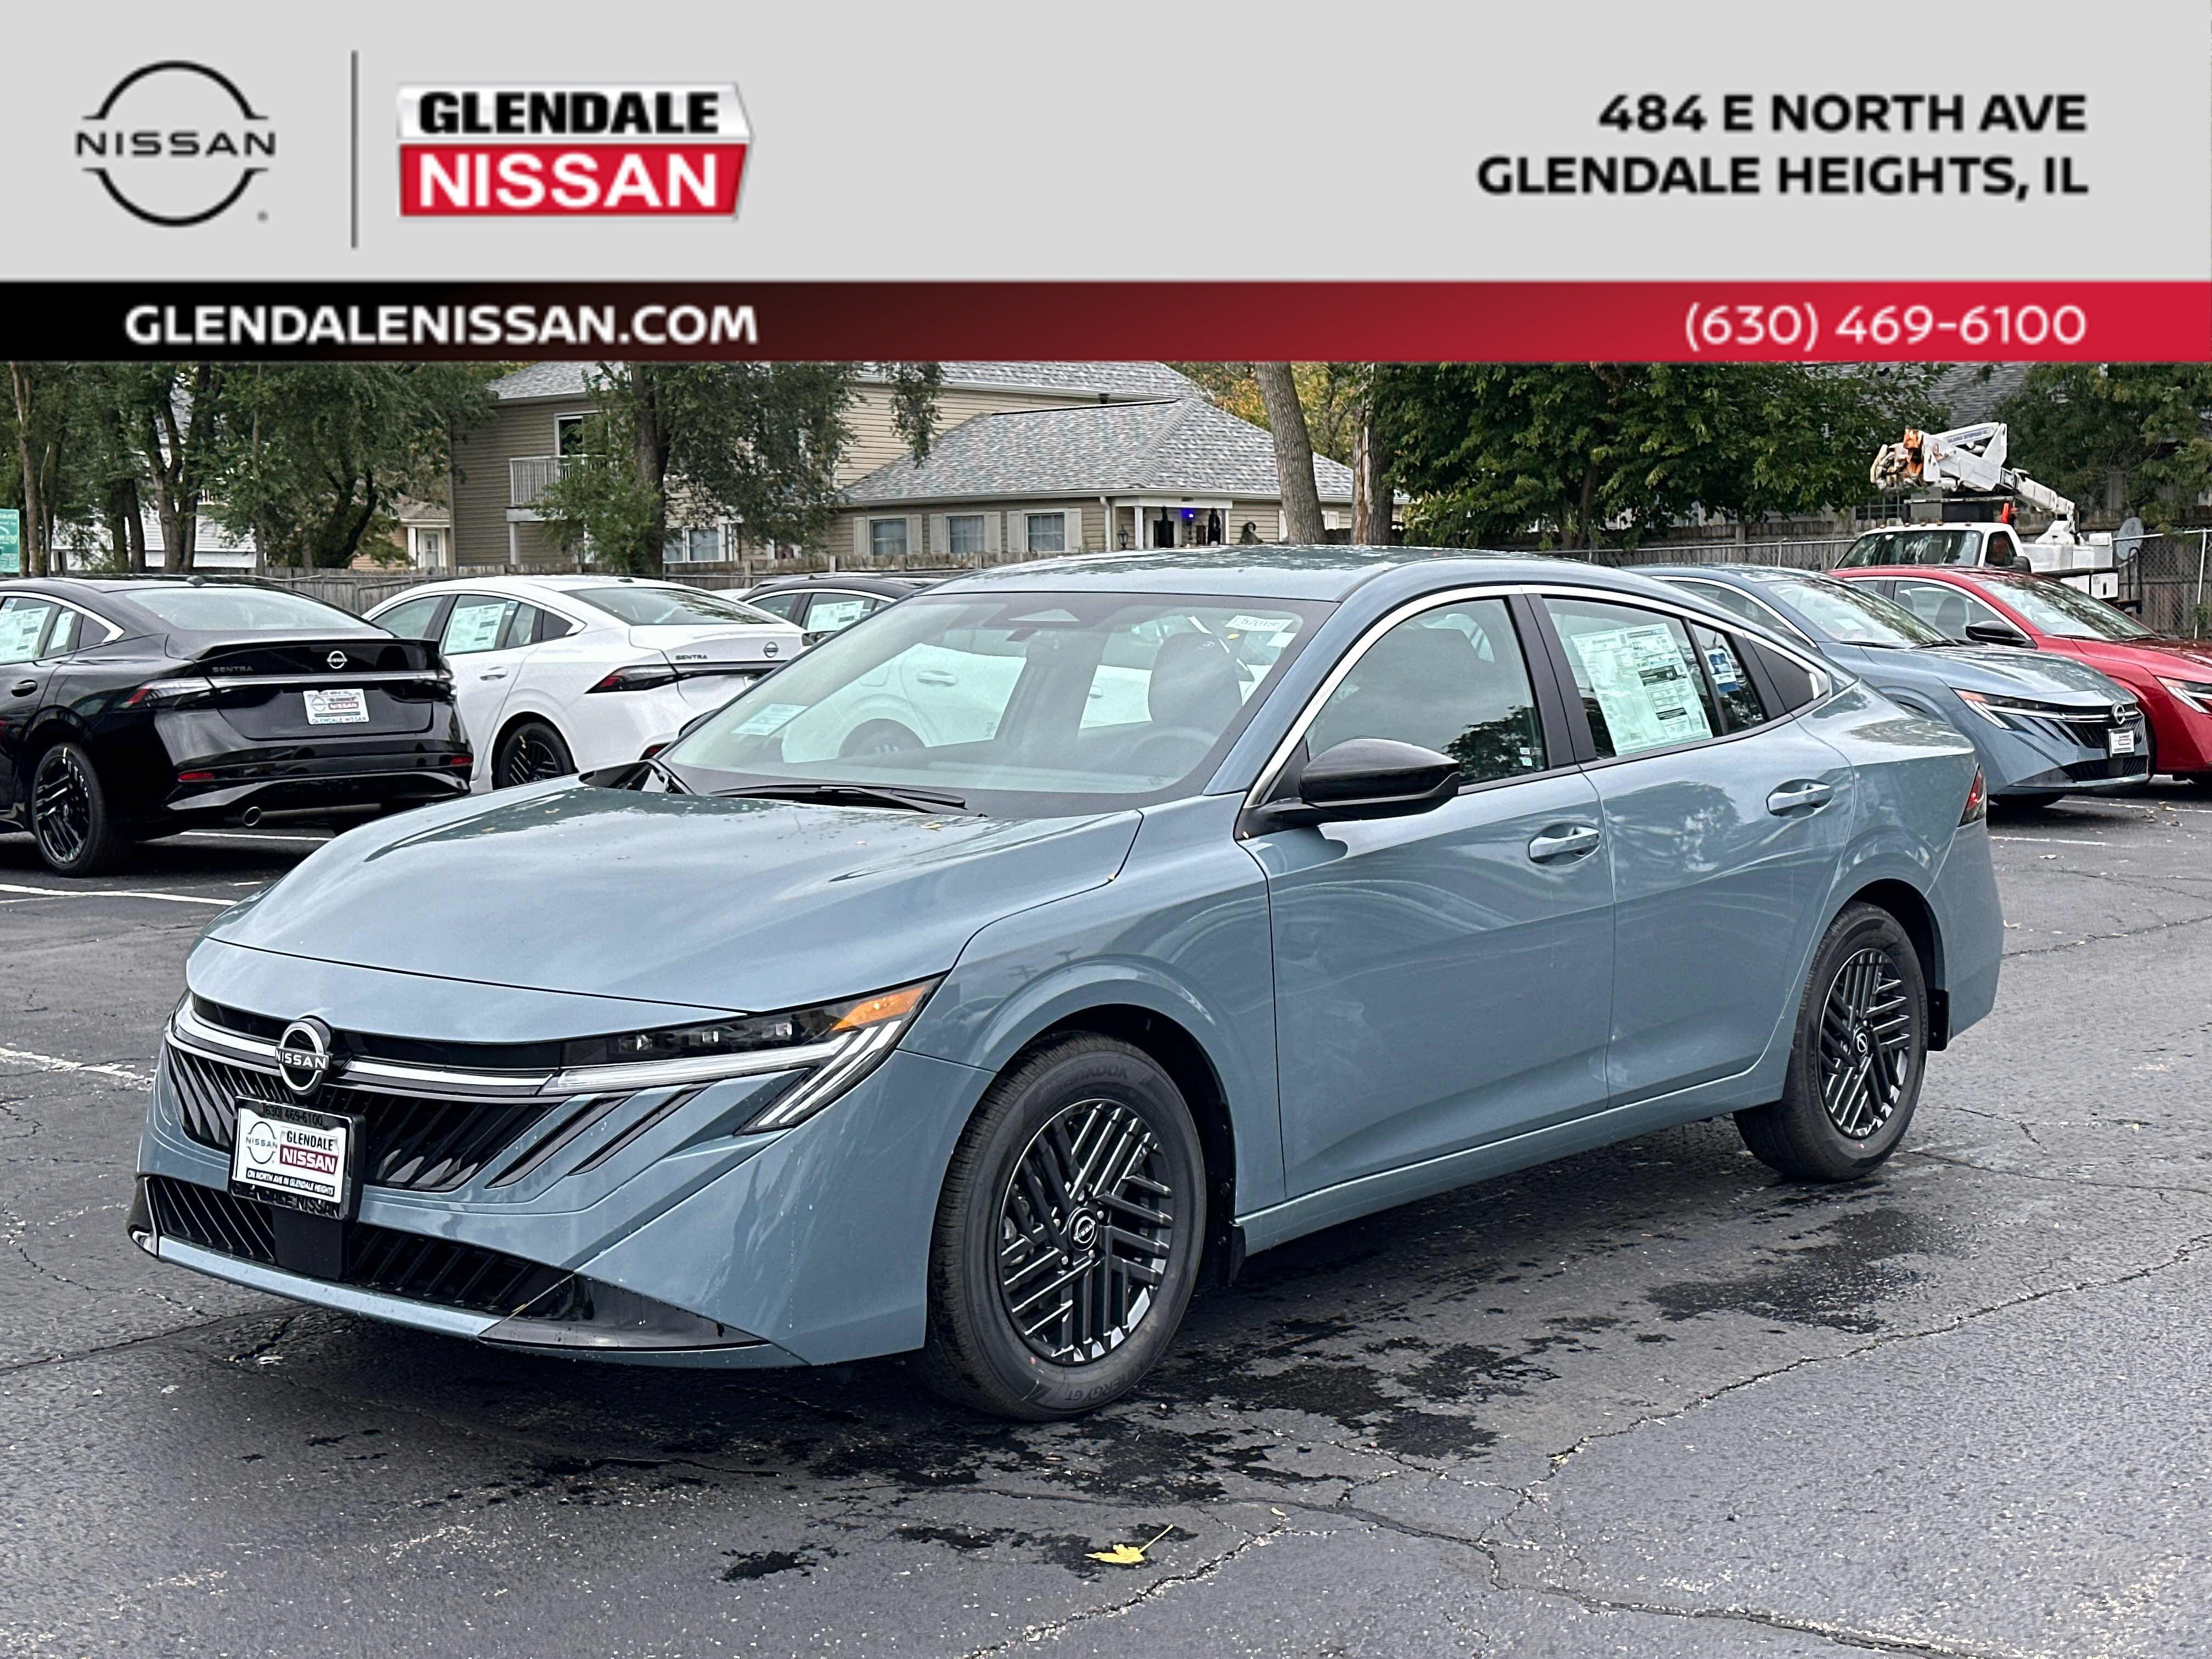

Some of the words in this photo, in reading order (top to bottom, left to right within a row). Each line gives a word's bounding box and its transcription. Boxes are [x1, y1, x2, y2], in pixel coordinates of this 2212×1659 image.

[275, 1048, 326, 1069] NISSAN
[246, 1136, 278, 1150] NISSAN
[286, 1130, 334, 1152] GLENDALE
[281, 1147, 336, 1173] NISSAN
[247, 1169, 256, 1178] ON
[256, 1171, 273, 1182] NORTH
[273, 1175, 283, 1184] AVE
[283, 1177, 290, 1186] IN
[289, 1178, 314, 1191] GLENDALE
[314, 1182, 334, 1196] HEIGHTS
